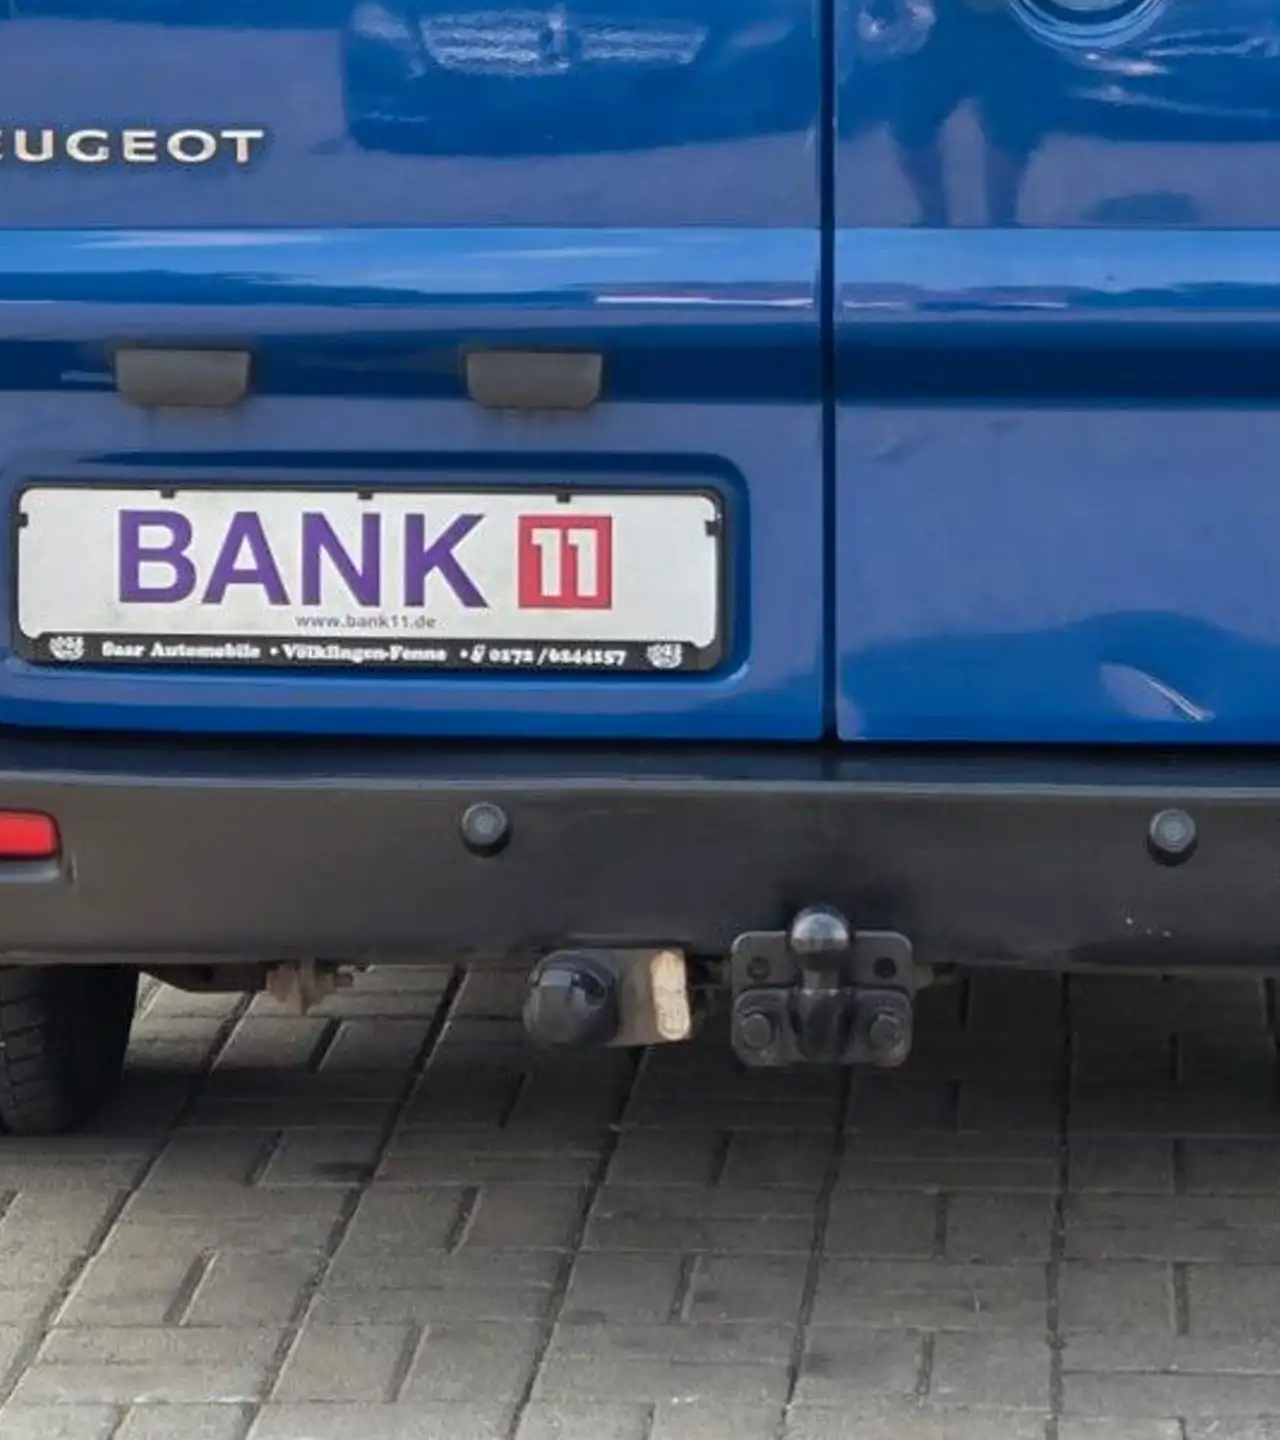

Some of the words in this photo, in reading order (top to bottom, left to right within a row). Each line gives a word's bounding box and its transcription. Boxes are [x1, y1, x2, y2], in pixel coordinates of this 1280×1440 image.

[119, 508, 489, 609] BANK
[530, 526, 600, 598] 11
[295, 614, 437, 629] www.bank11.de
[150, 641, 261, 659] Automobile
